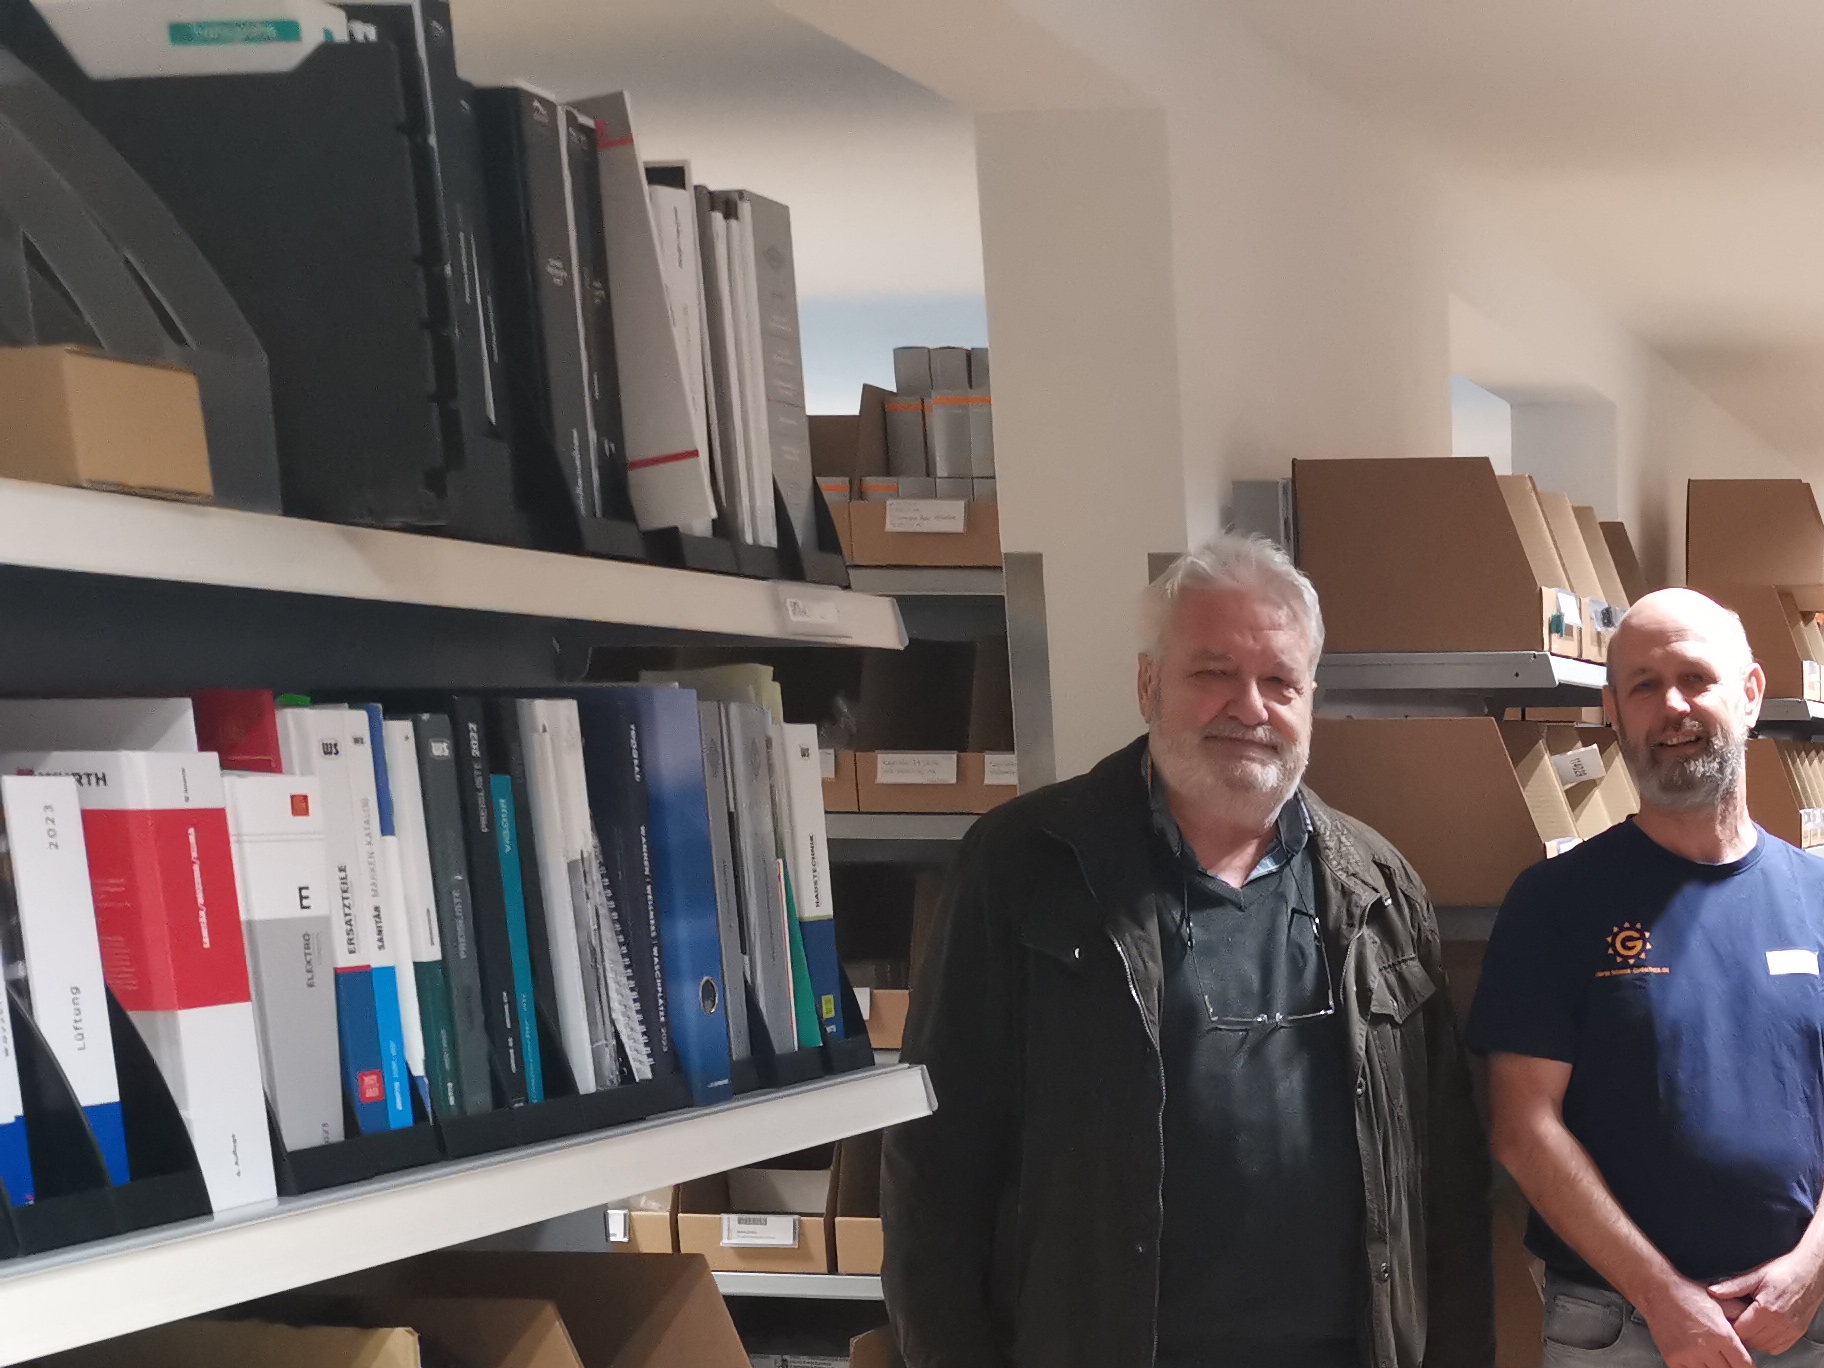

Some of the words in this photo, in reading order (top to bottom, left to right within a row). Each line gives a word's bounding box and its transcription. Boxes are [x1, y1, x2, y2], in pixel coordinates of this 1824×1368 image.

[44, 804, 59, 850] 2023
[337, 864, 359, 955] ERSATZTEILE
[303, 931, 316, 988] ELEKTRO
[73, 985, 85, 1053] Lüftung
